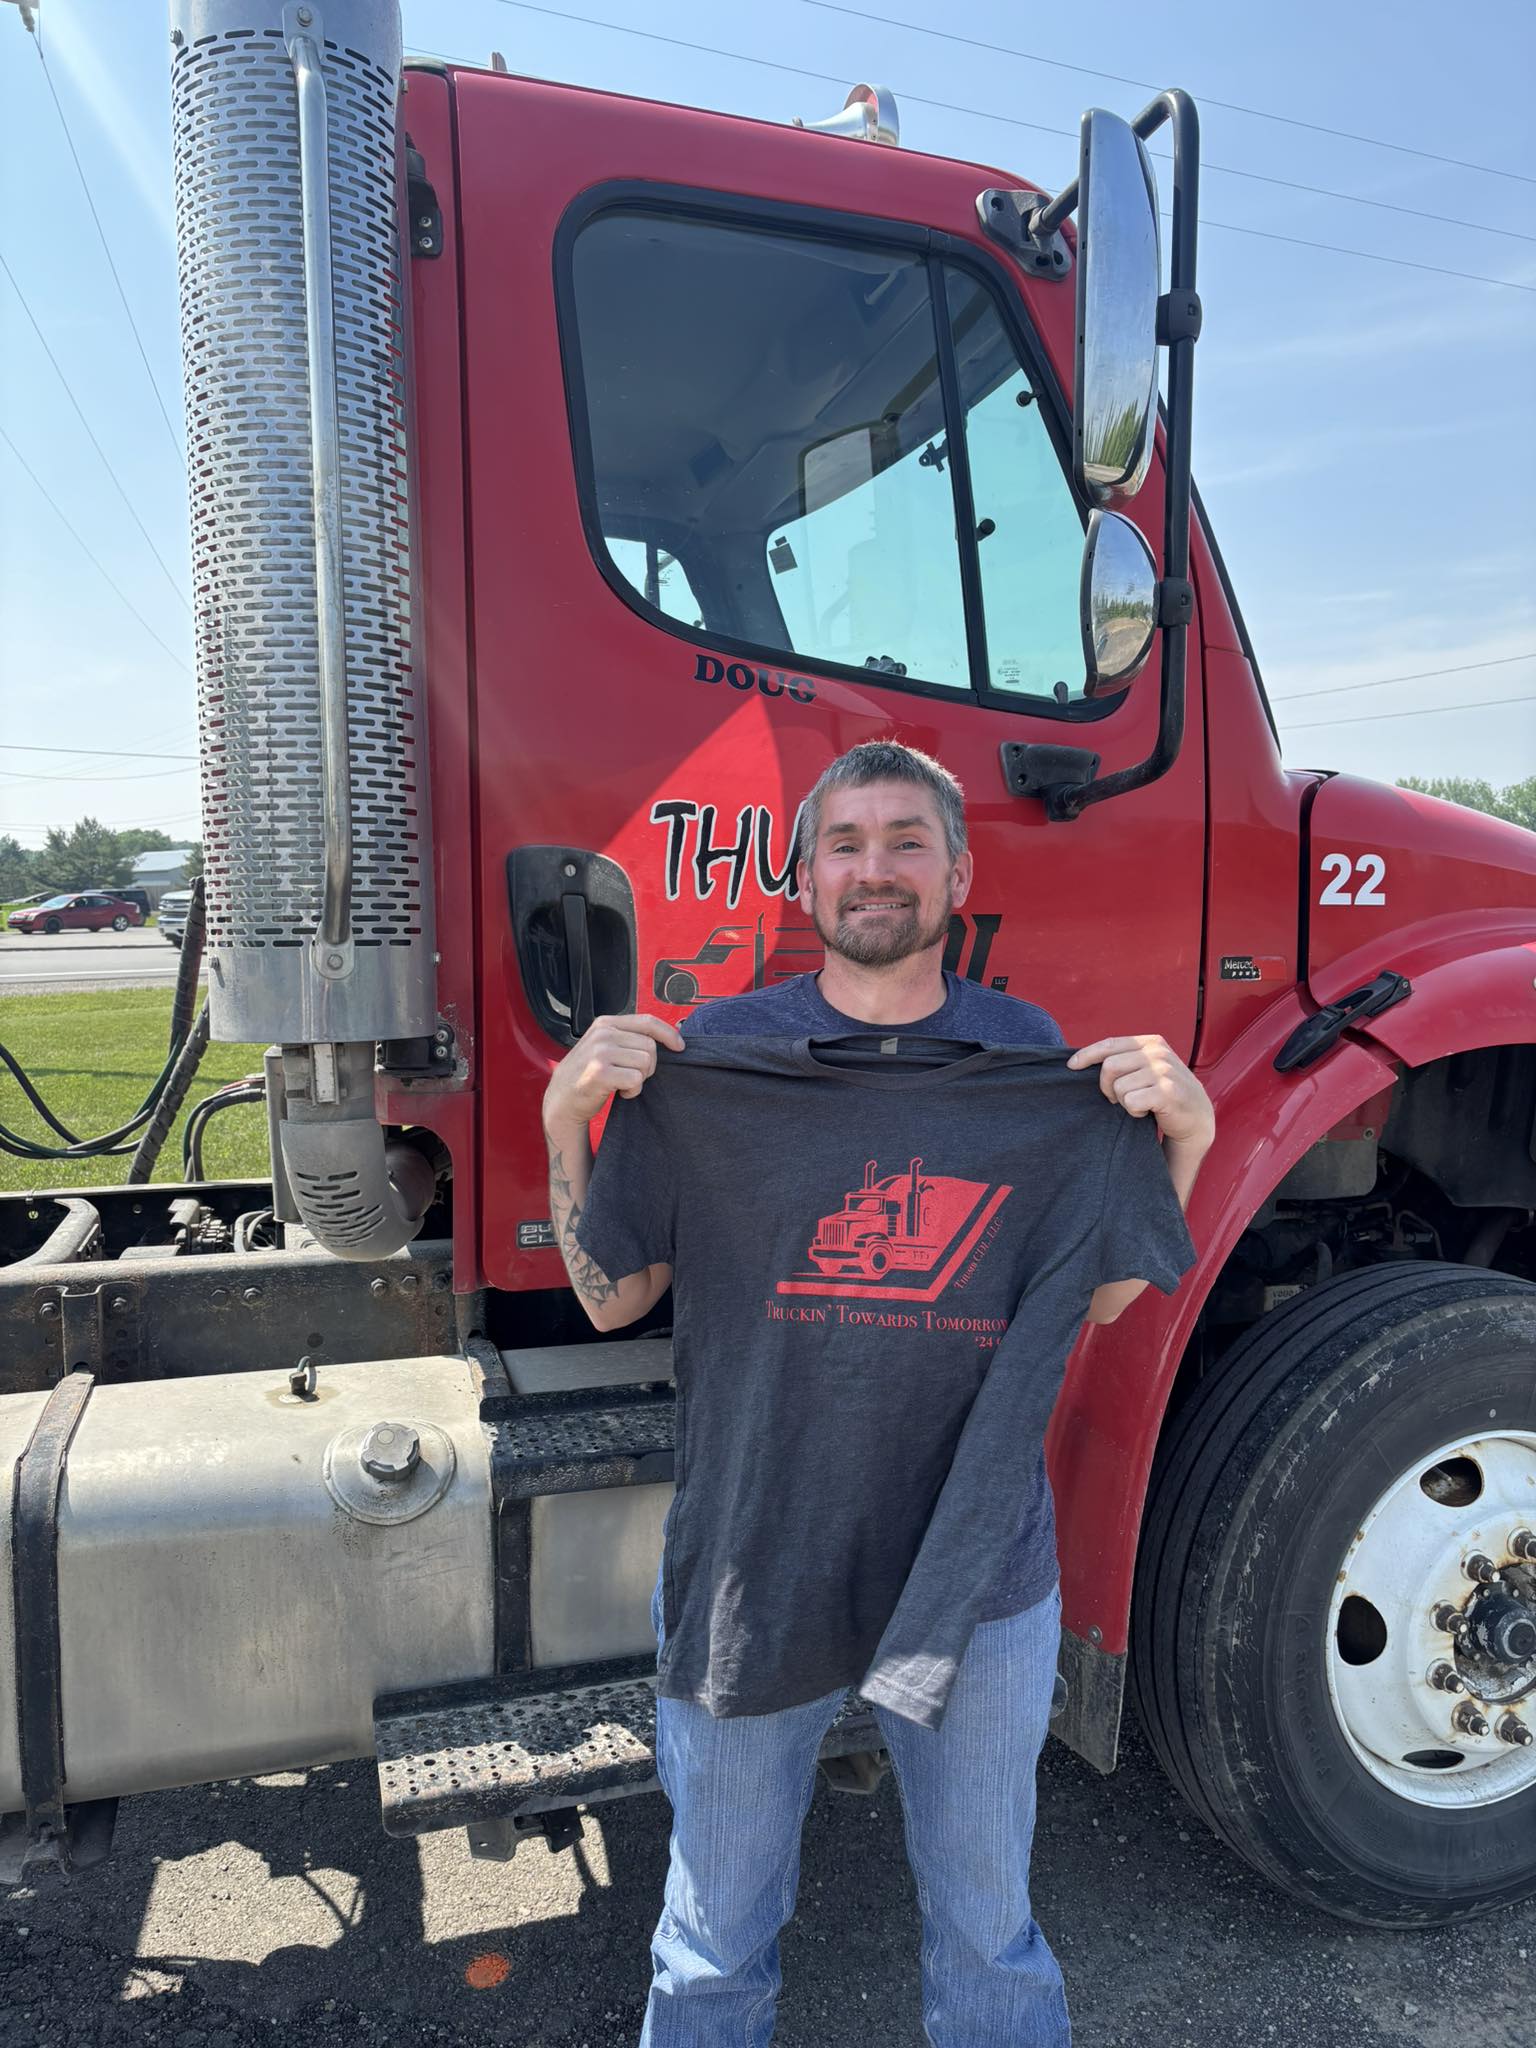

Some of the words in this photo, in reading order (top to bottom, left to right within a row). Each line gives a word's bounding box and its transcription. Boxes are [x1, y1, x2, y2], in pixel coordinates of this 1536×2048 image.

[694, 655, 817, 704] DOUG
[650, 799, 802, 909] THU
[1319, 853, 1386, 906] 22
[836, 1304, 918, 1328] TOWARDS
